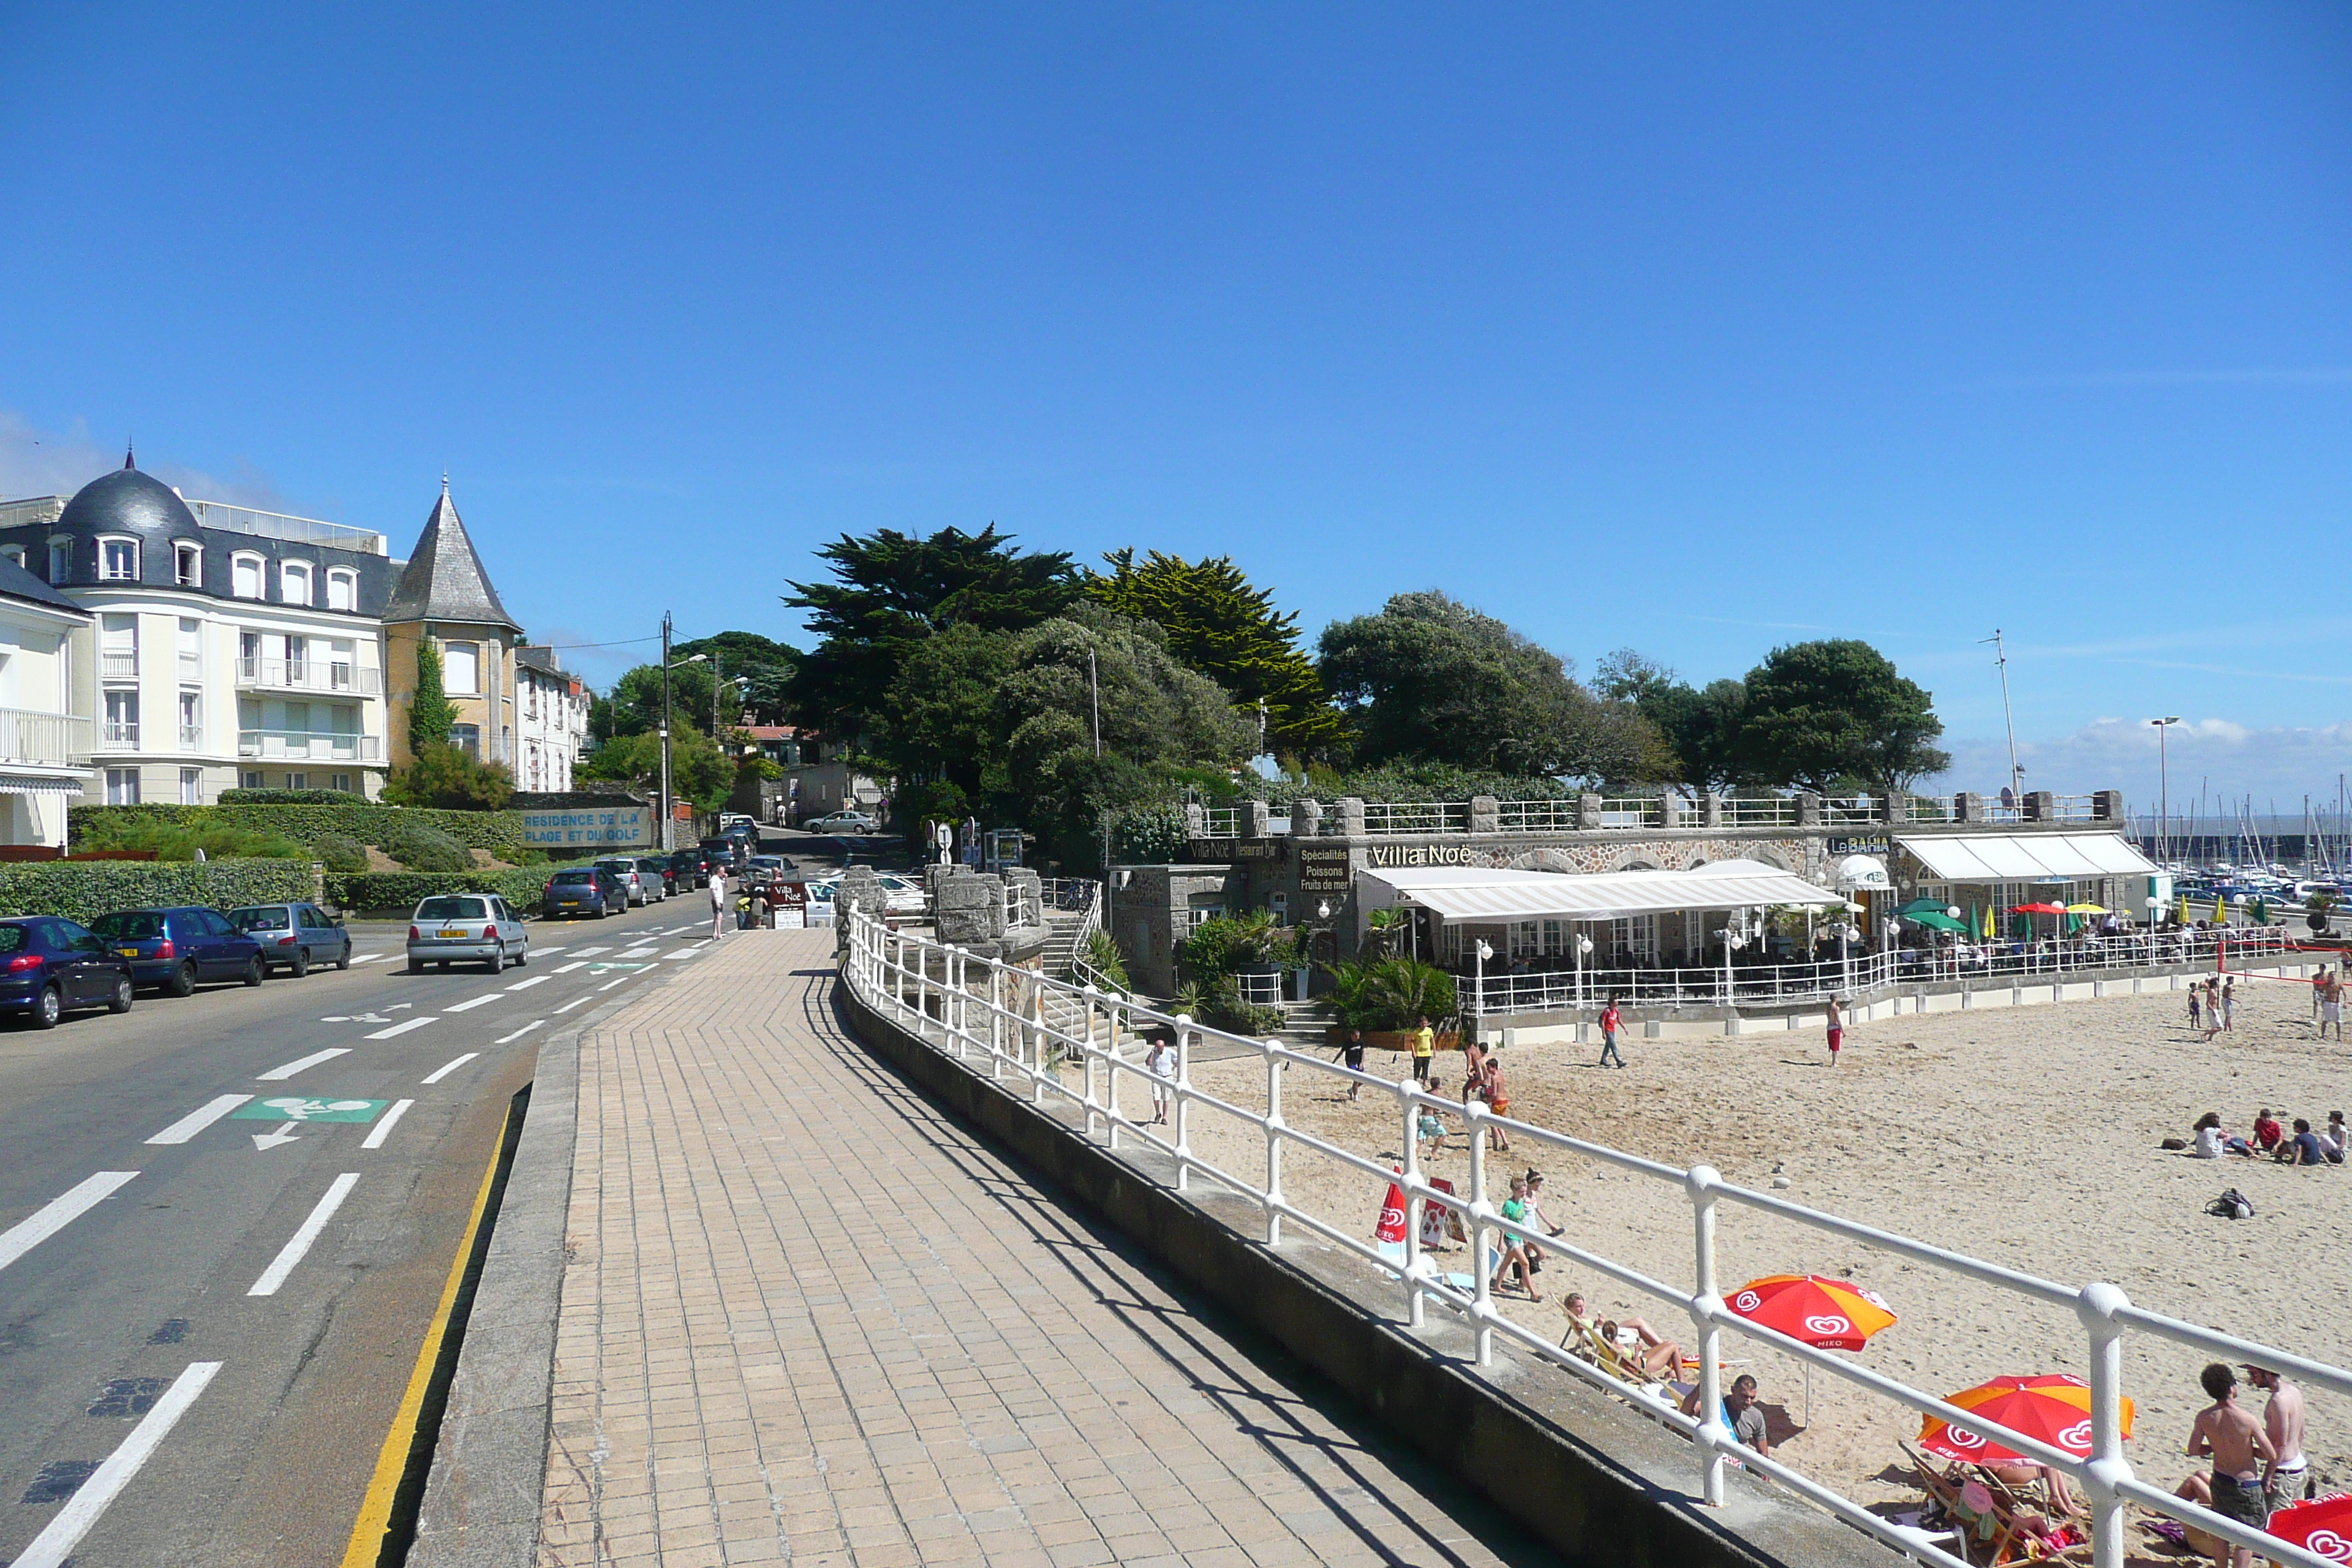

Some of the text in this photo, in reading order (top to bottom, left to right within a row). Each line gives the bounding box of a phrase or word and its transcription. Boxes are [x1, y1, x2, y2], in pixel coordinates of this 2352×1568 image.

[524, 813, 639, 827] RESIDENCE DE LA
[524, 829, 640, 842] PLAGE ET DU GOLF
[1189, 840, 1276, 859] Villa Noë Restaurant Bar
[1832, 837, 1889, 853] Le BAHIA
[1301, 848, 1348, 863] Spécialités
[1373, 843, 1471, 866] Villa Noë
[1306, 865, 1343, 878] Poissons
[774, 886, 792, 894] Villa
[1300, 879, 1349, 890] Fruits de mer
[785, 892, 801, 901] Noë
